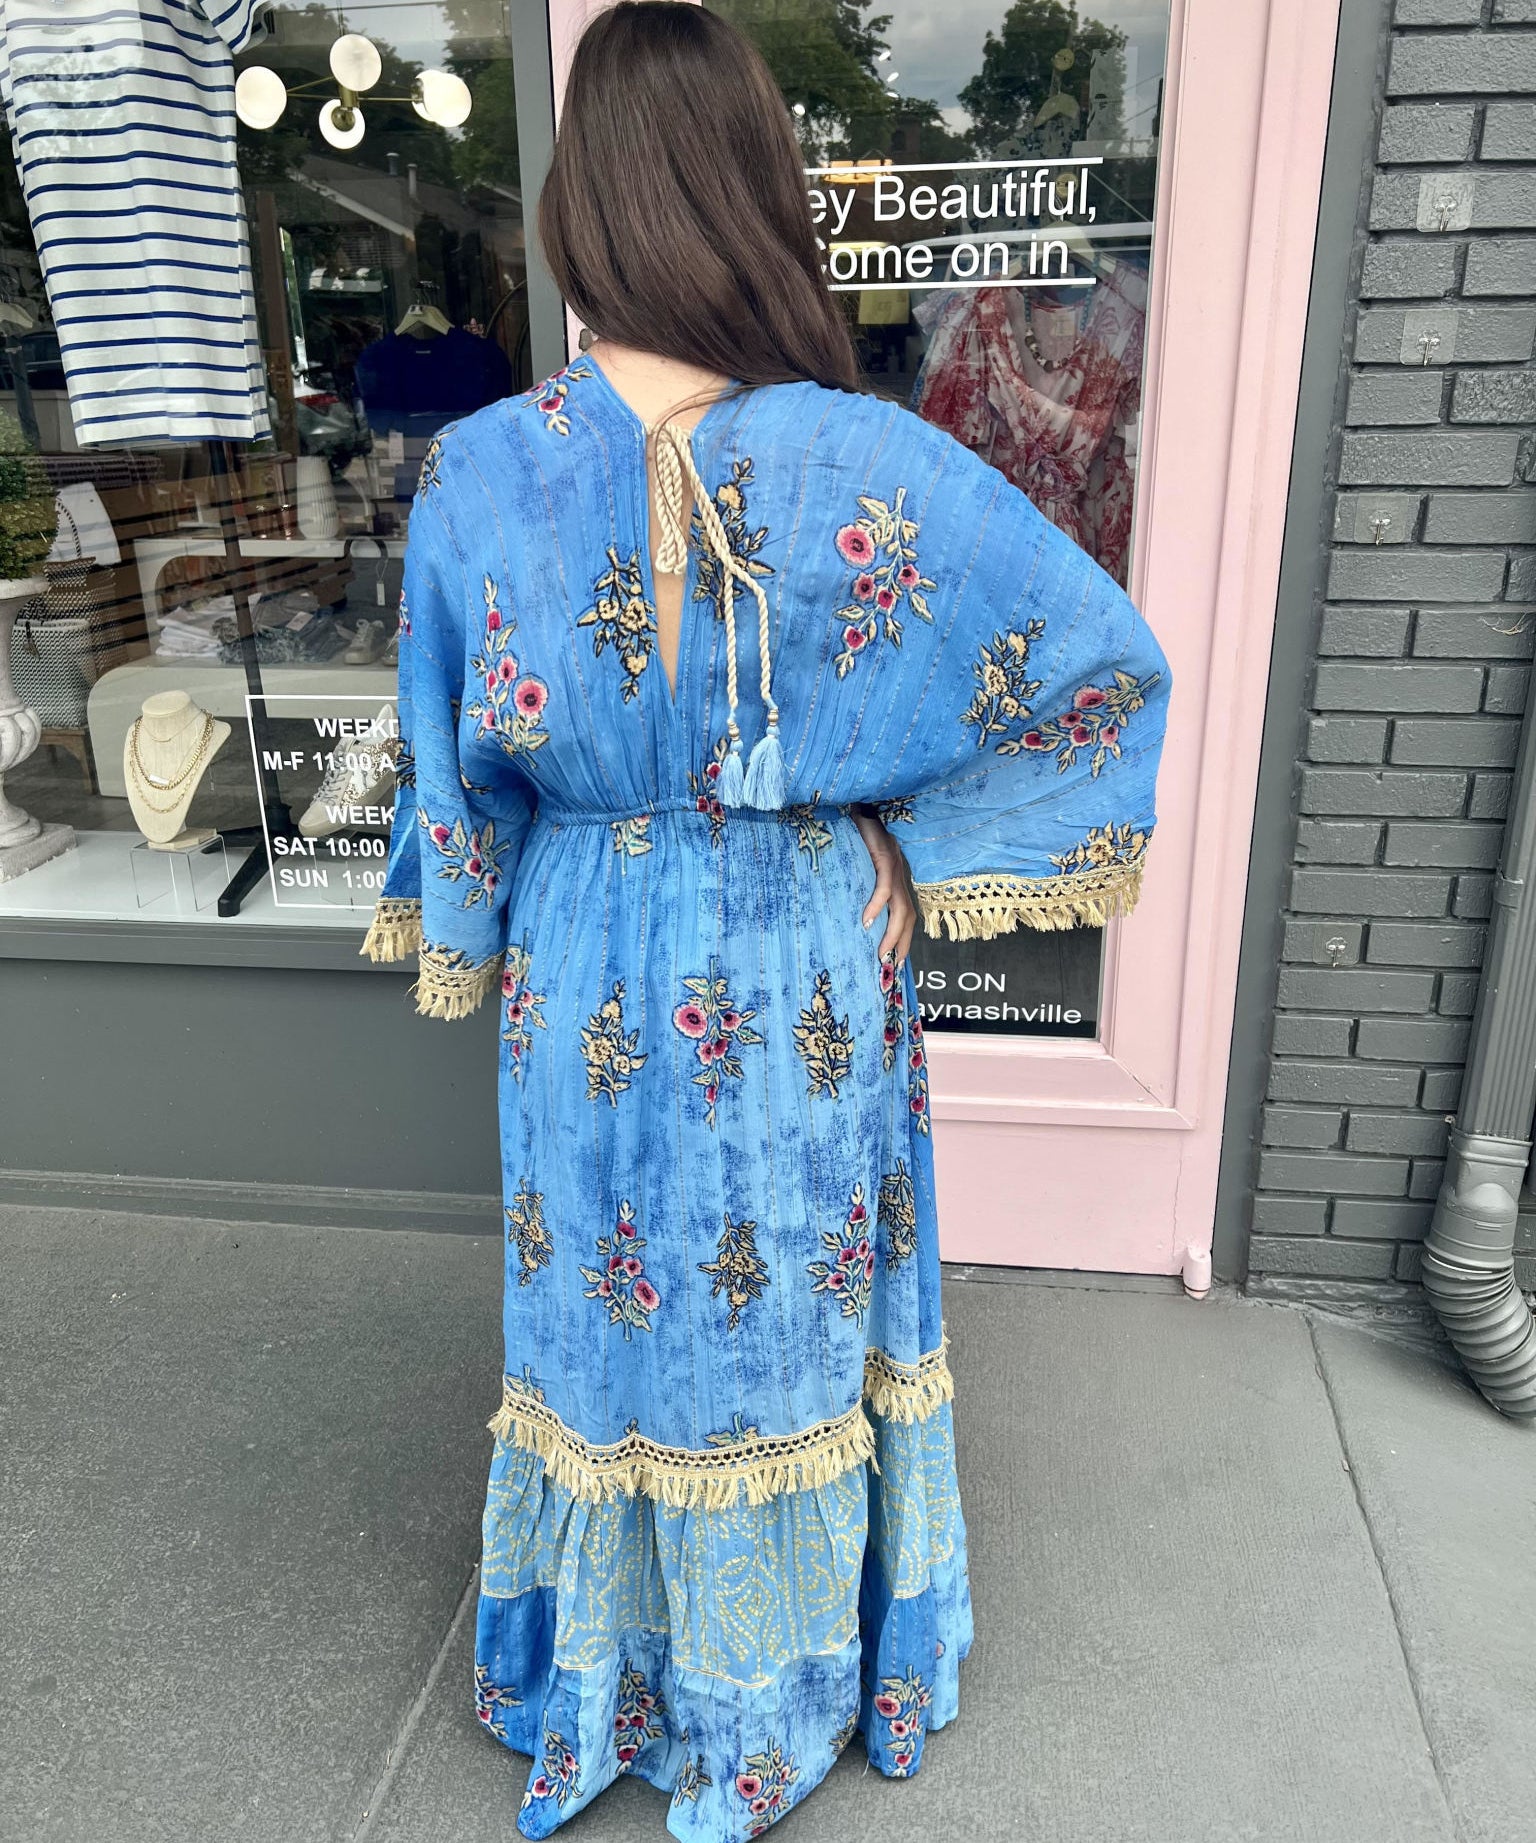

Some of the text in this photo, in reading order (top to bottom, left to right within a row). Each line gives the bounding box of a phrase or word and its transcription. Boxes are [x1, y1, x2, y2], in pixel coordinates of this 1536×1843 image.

[874, 167, 1096, 223] Beautiful,
[815, 232, 1068, 280] ome on in
[262, 750, 304, 771] M-F
[312, 751, 373, 772] 11:00
[325, 805, 396, 825] WEEK
[273, 836, 386, 858] SAT 10:00
[279, 868, 387, 889] SUN 1:00
[957, 972, 1006, 993] ON
